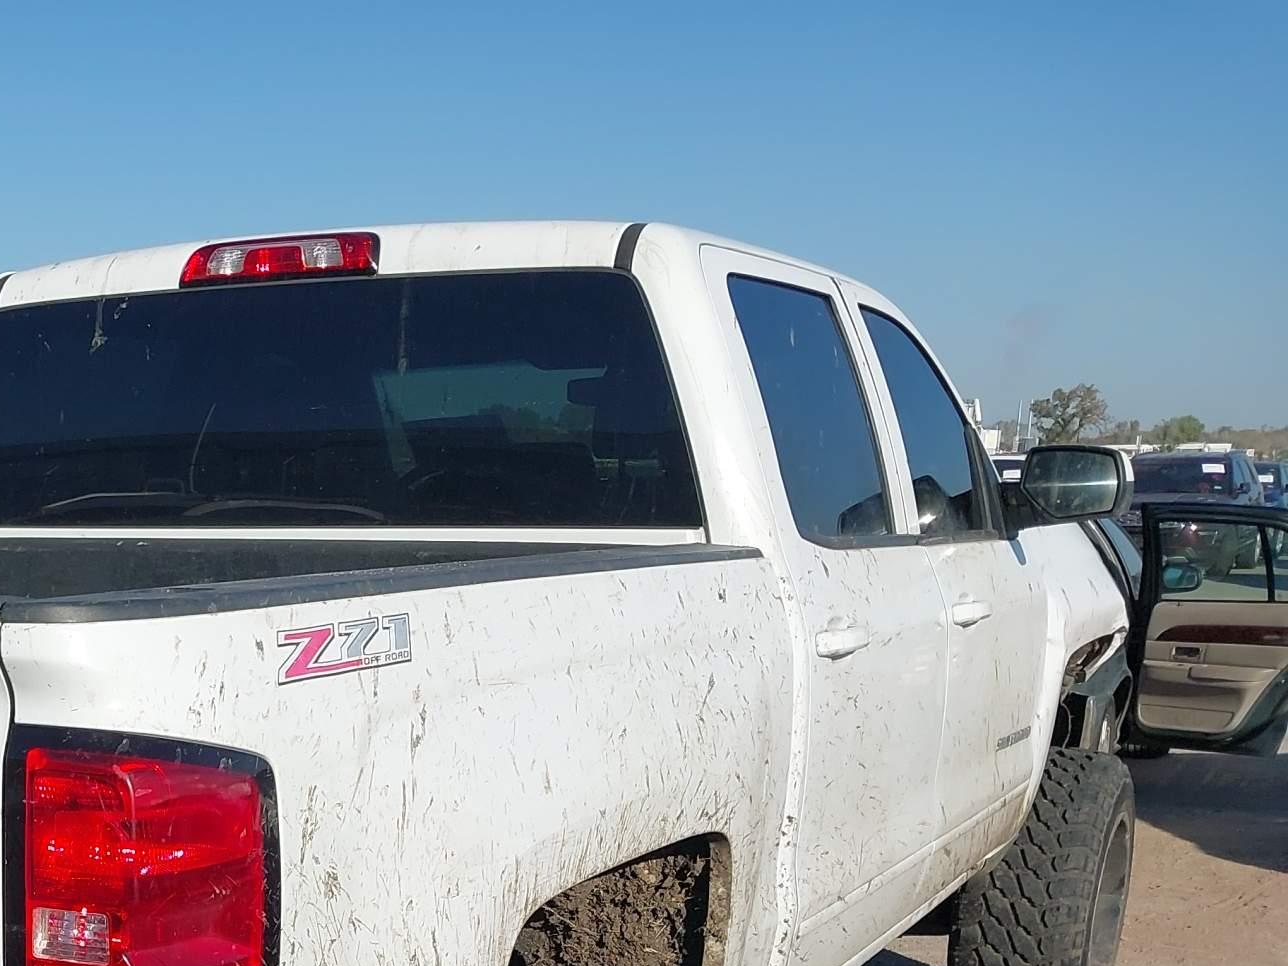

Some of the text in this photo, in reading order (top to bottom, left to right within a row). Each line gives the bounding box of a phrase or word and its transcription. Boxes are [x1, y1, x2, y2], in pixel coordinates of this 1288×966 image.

[277, 613, 411, 685] Z71
[363, 651, 409, 666] OFF ROAD
